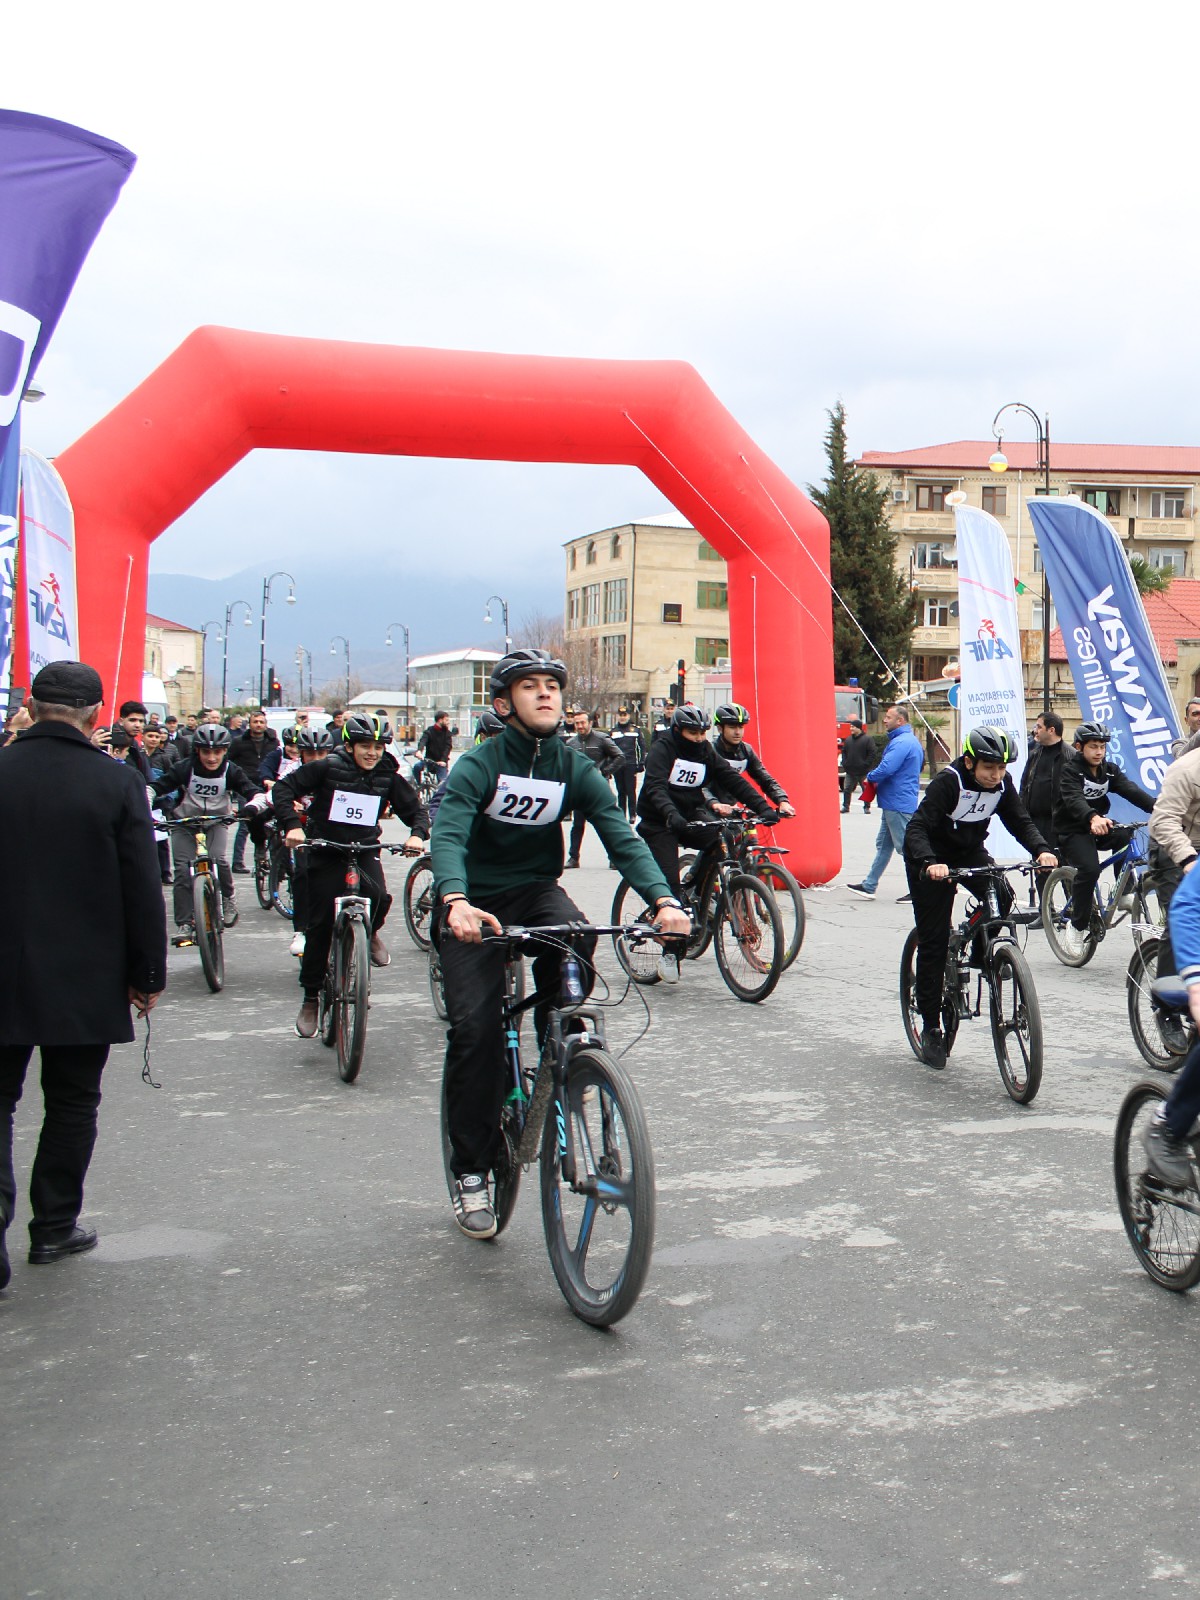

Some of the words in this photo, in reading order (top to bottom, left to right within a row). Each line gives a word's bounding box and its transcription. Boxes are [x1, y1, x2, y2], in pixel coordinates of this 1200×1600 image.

[676, 769, 698, 785] 215
[194, 784, 219, 796] 229
[1084, 787, 1105, 797] 226
[345, 807, 363, 819] 95
[498, 793, 549, 821] 227
